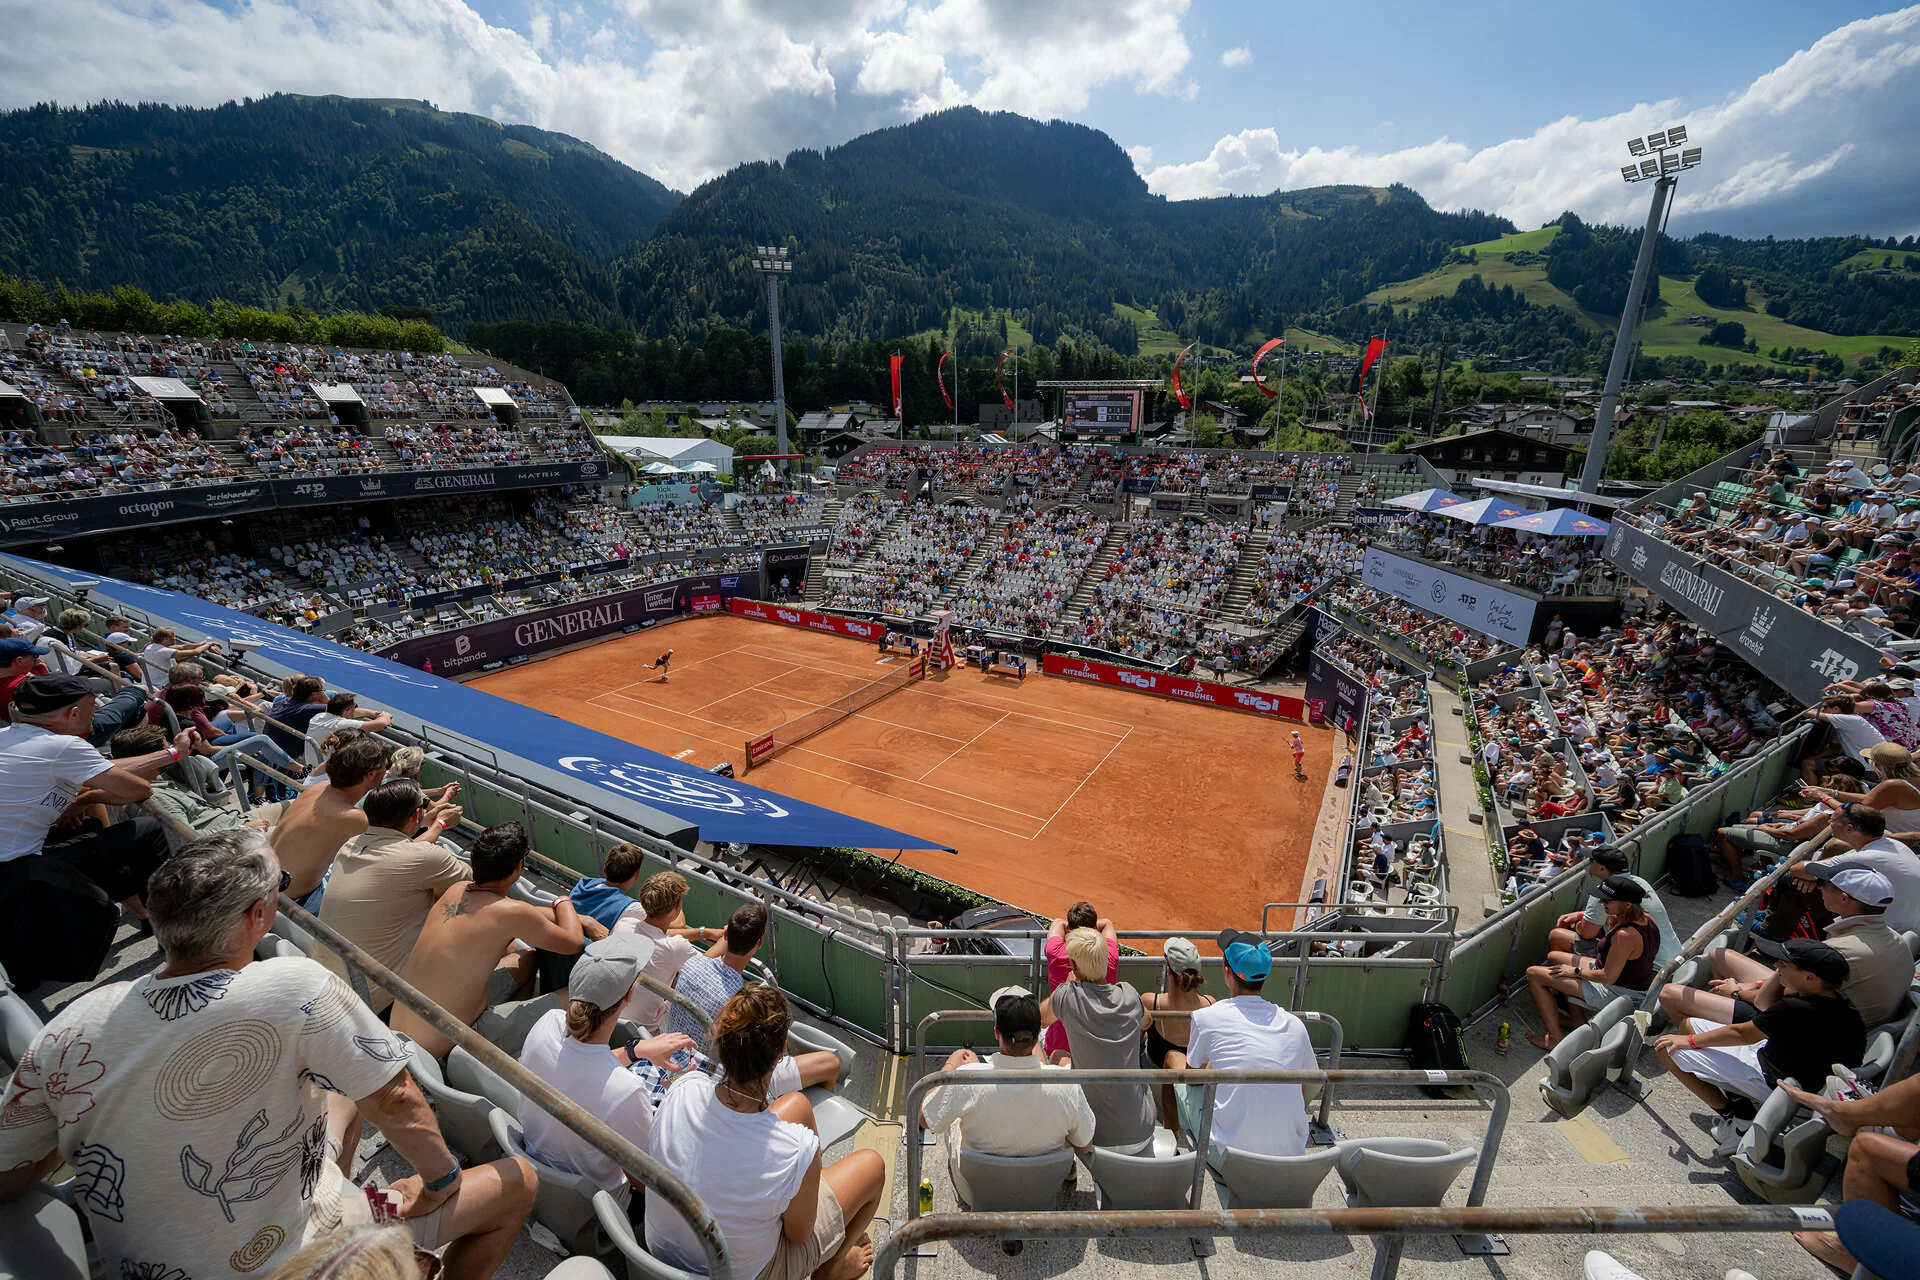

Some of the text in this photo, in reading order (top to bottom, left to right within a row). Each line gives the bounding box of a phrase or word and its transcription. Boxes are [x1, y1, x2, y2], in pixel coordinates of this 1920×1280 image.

[434, 473, 496, 488] GENERALI
[518, 471, 560, 479] MATRIX
[293, 484, 325, 494] ATP
[119, 500, 174, 517] octagon
[10, 512, 79, 527] Rent.Group
[1354, 514, 1378, 524] Krone
[647, 593, 663, 601] inter
[1672, 566, 1725, 617] GENERALI
[649, 598, 672, 607] wetten
[706, 602, 720, 610] 1:00
[1458, 593, 1477, 605] ATP
[744, 609, 768, 618] KITZBÜHEL
[776, 610, 800, 623] Tirol
[514, 602, 625, 648] GENERALI
[809, 621, 835, 631] KITZBÜHEL
[845, 622, 871, 636] Tirol
[1738, 630, 1764, 656] kronehit
[443, 650, 487, 669] bitpanda
[1810, 648, 1859, 682] ATP
[1062, 667, 1100, 680] KITZBÜHEL
[1117, 671, 1156, 689] Tirol
[1171, 688, 1214, 702] KITZBÜHEL
[1234, 692, 1279, 711] Tirol
